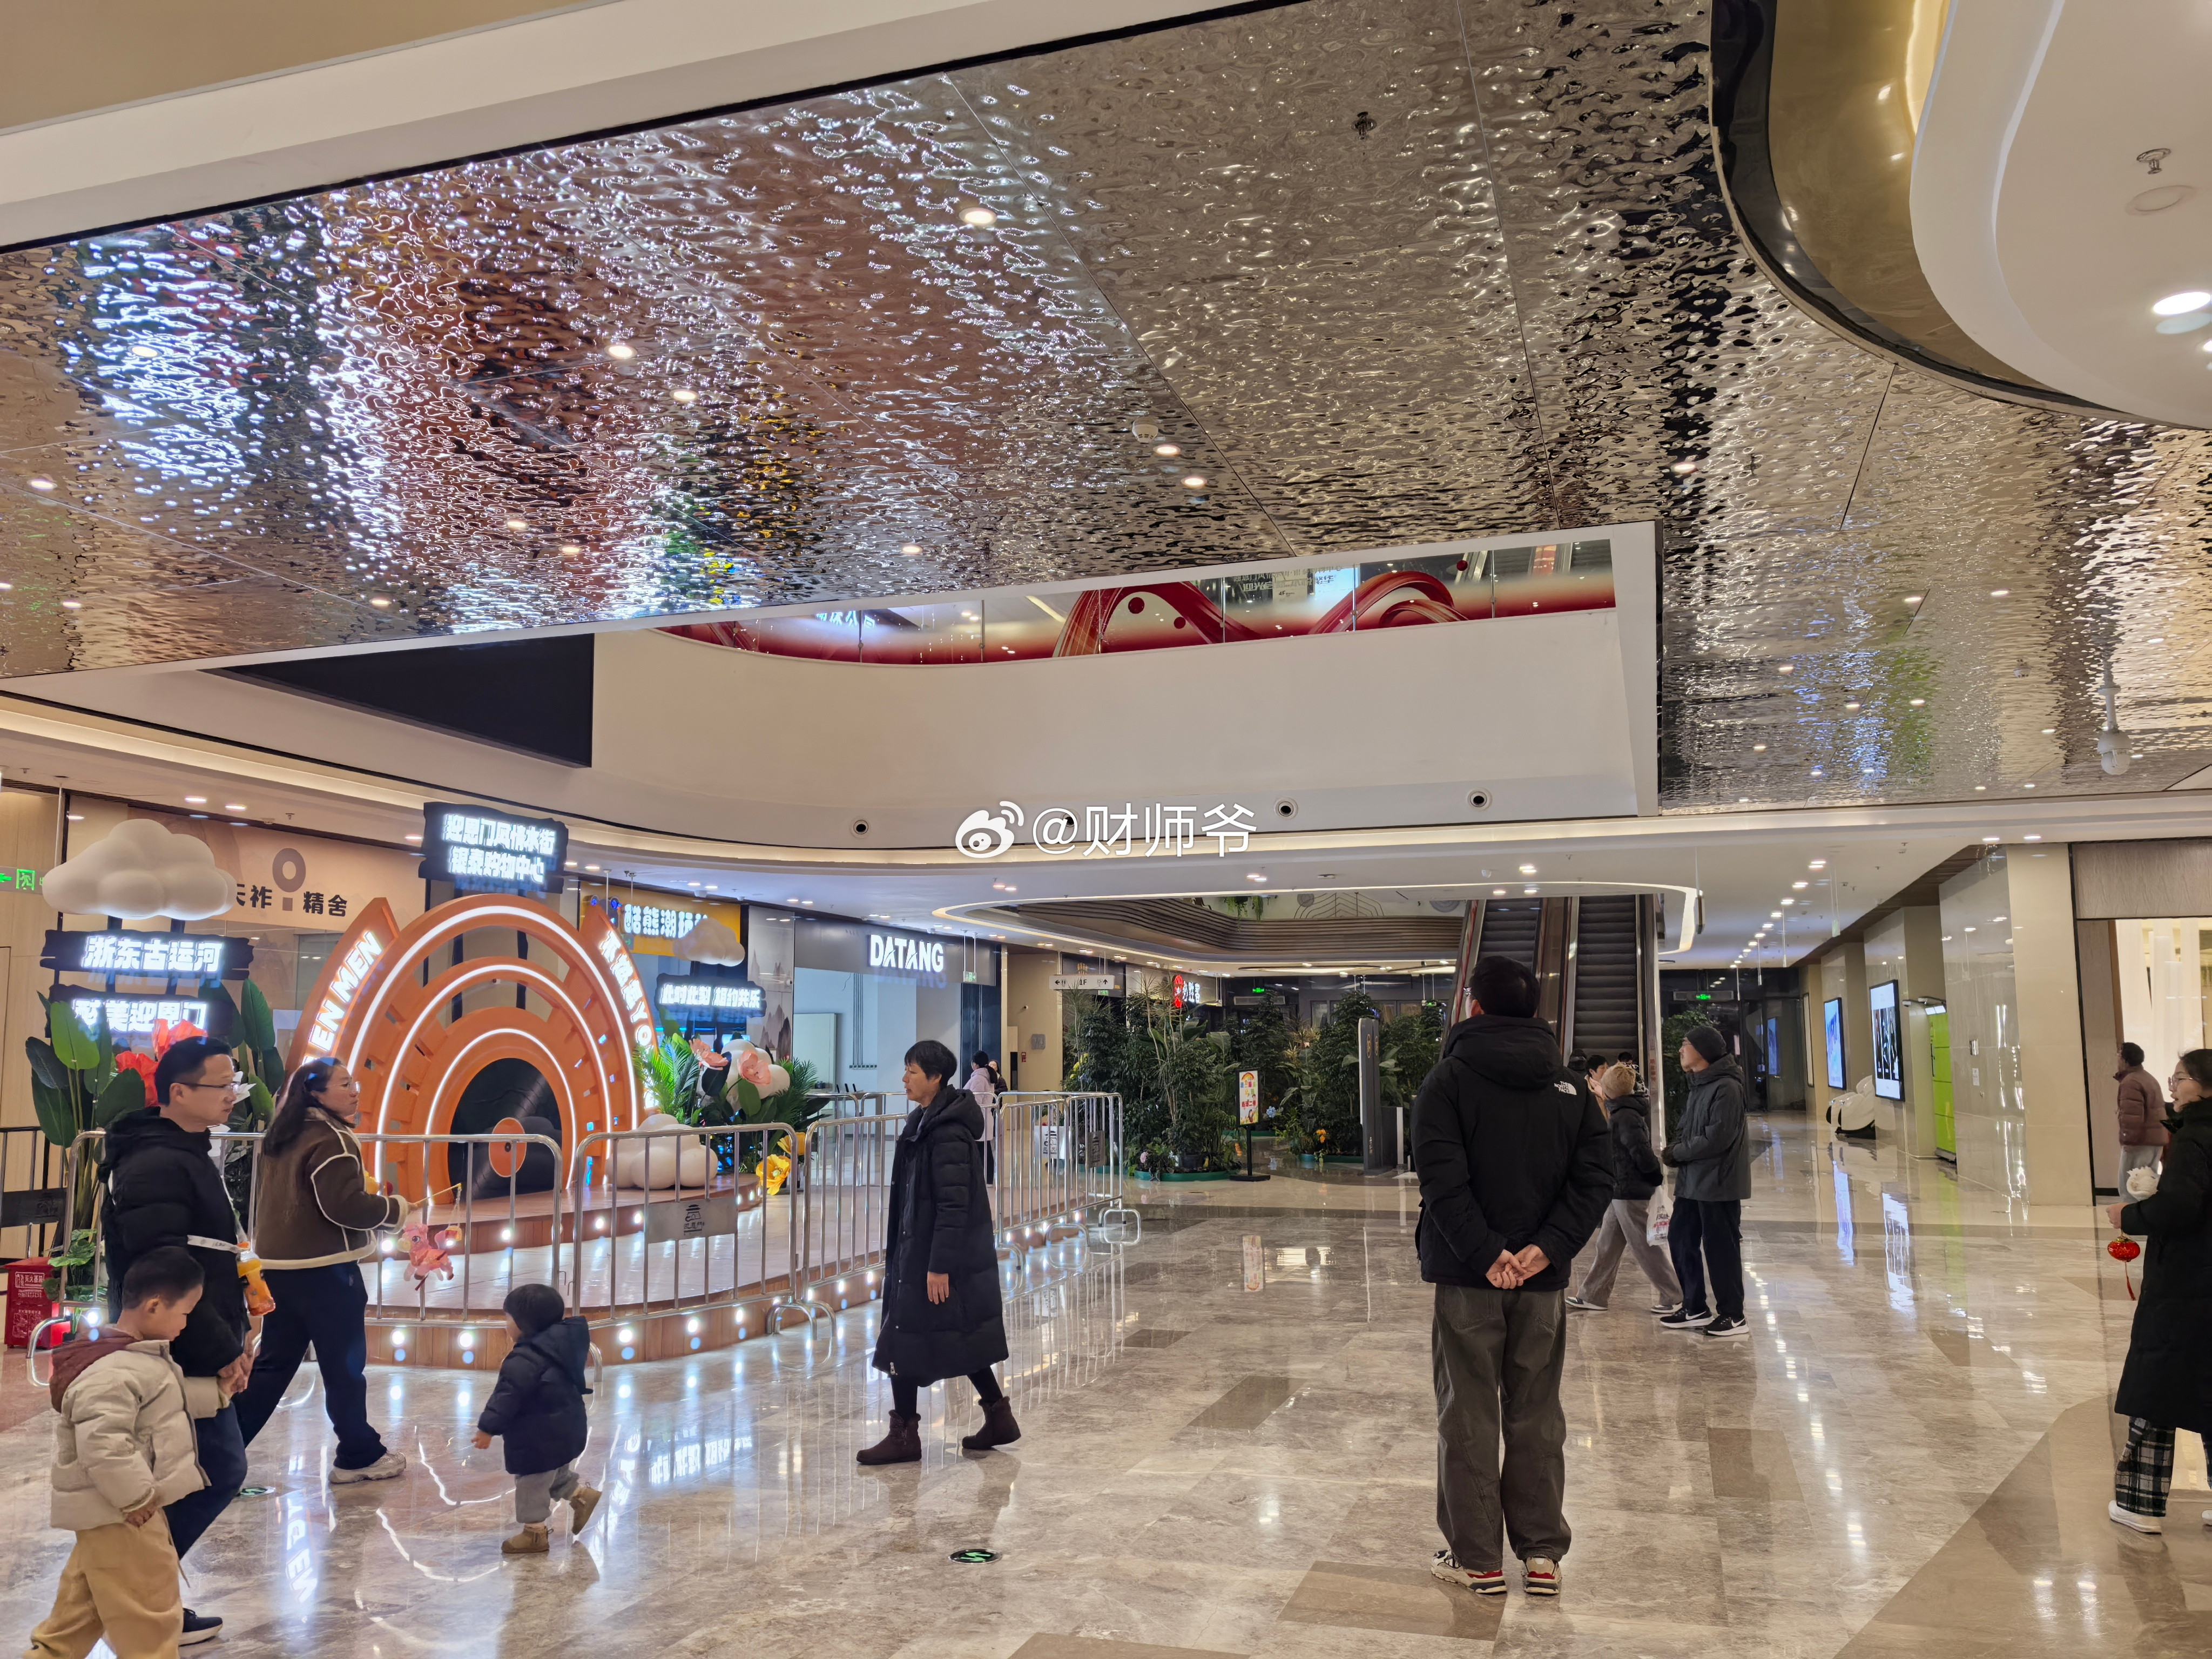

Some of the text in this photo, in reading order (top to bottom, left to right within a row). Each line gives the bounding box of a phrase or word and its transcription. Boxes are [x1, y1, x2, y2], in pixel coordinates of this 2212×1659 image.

[303, 891, 348, 917] 精舍
[624, 904, 708, 939] 酷熊潮玩
[82, 935, 224, 973] 浙东古运河
[870, 934, 944, 973] DATANG
